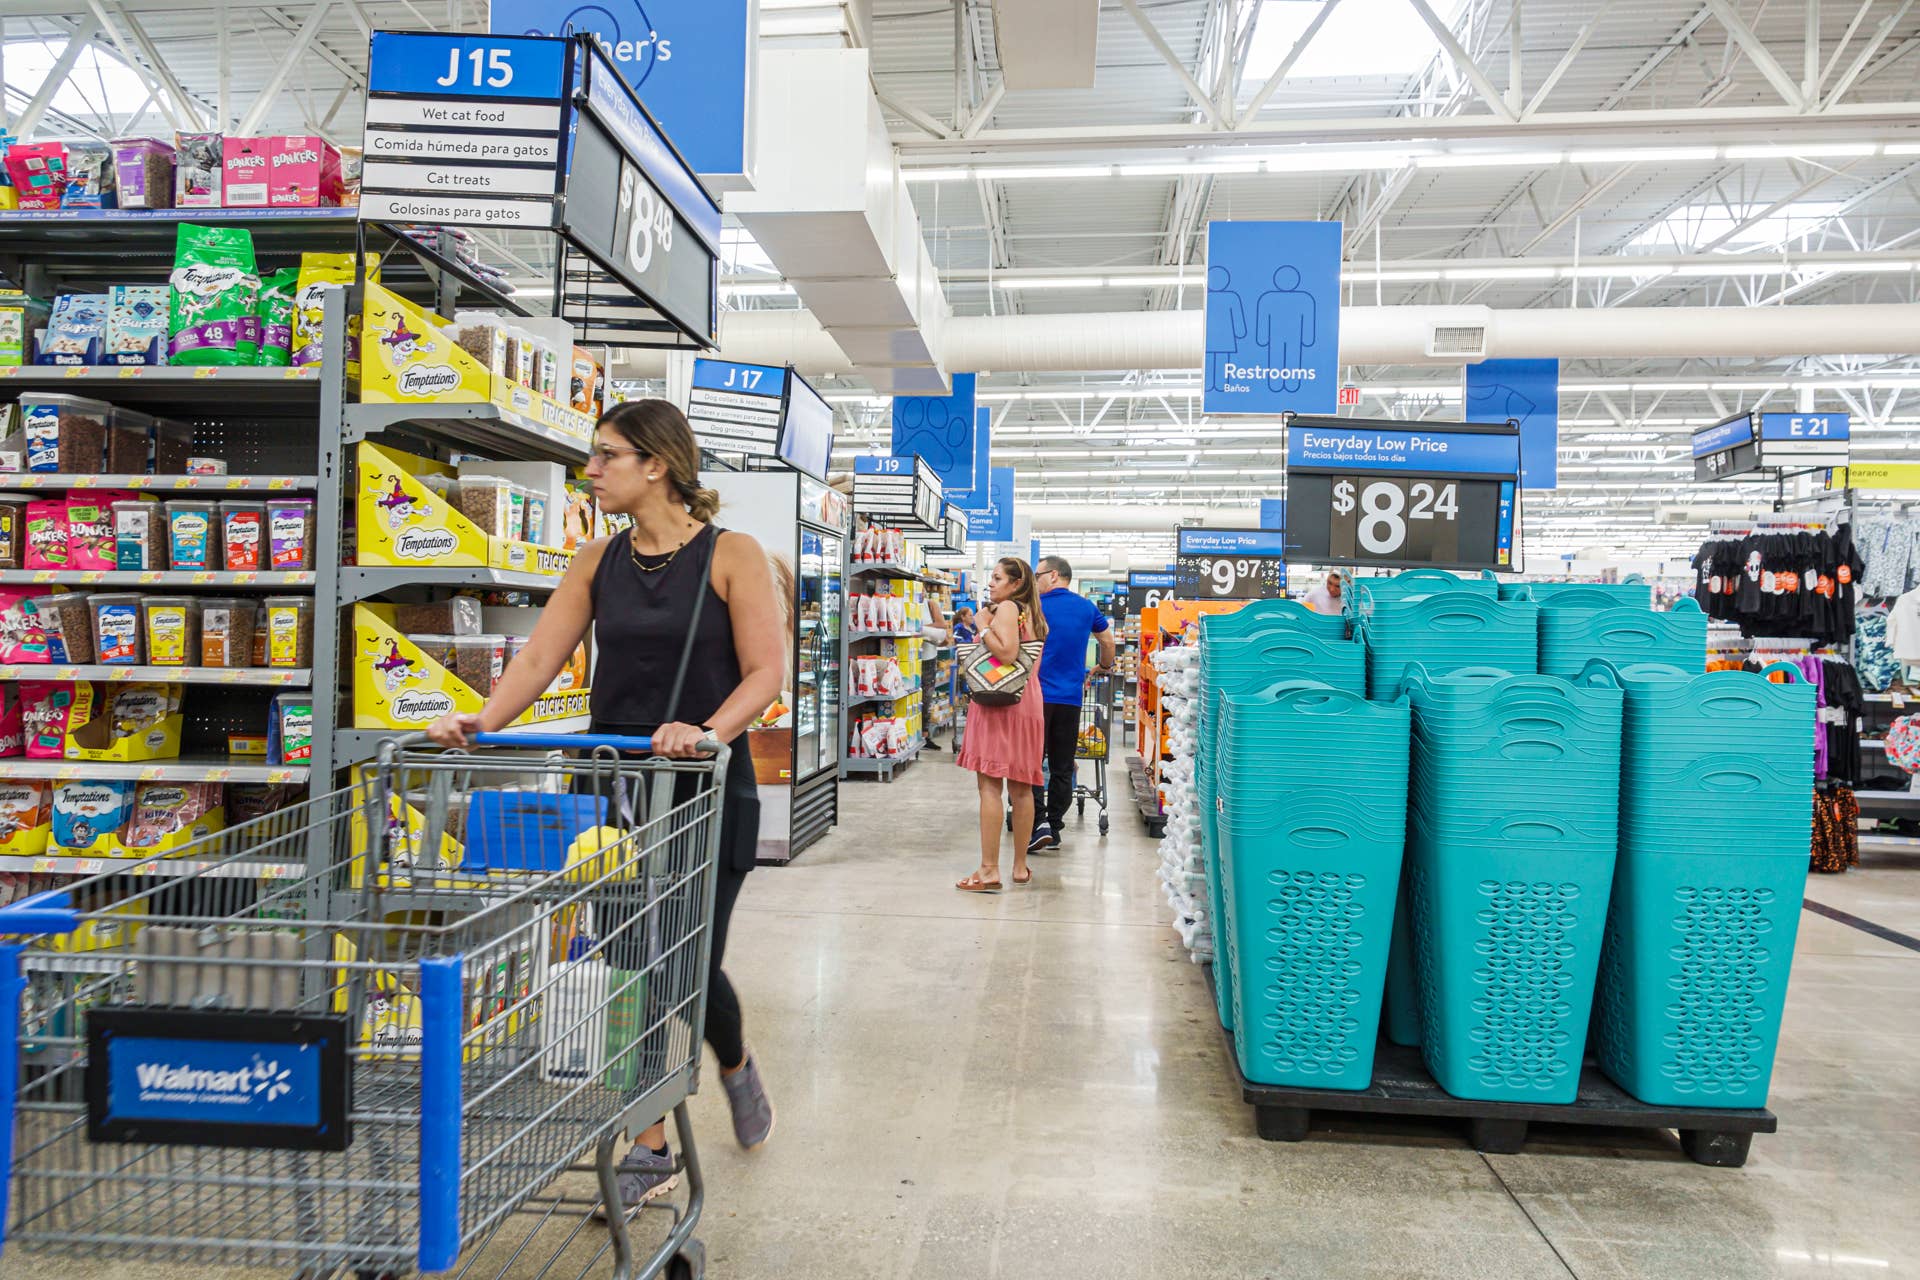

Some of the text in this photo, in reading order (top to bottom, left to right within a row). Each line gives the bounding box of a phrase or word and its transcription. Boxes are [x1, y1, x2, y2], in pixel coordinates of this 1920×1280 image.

[423, 108, 505, 122] Wet cat food
[374, 138, 549, 158] Comida húmeda para gatos
[227, 155, 266, 170] BONKERS
[272, 150, 318, 168] BONKERS
[427, 172, 491, 186] Cat treats
[389, 202, 520, 220] Golosinas para gatos
[204, 327, 223, 340] 48
[1224, 363, 1316, 380] Restrooms
[403, 371, 457, 391] Temptations
[1224, 384, 1251, 393] Baños
[1339, 388, 1360, 404] EXIT
[542, 400, 576, 433] TRICKS
[1303, 433, 1448, 453] Everyday Low Price
[44, 451, 56, 460] 30
[1303, 451, 1331, 460] Precios
[1333, 452, 1353, 462] bajos
[1354, 453, 1377, 462] todos
[1378, 454, 1389, 462] los
[970, 517, 993, 525] Games
[398, 535, 453, 552] Temptations
[1186, 535, 1257, 546] Everyday Low Price
[537, 549, 570, 571] TRICKS
[72, 691, 92, 725] VALUE
[396, 698, 450, 715] Temptations
[533, 694, 585, 718] TRICKS FOR
[63, 788, 111, 806] Temptations
[136, 1062, 253, 1093] Walmart
